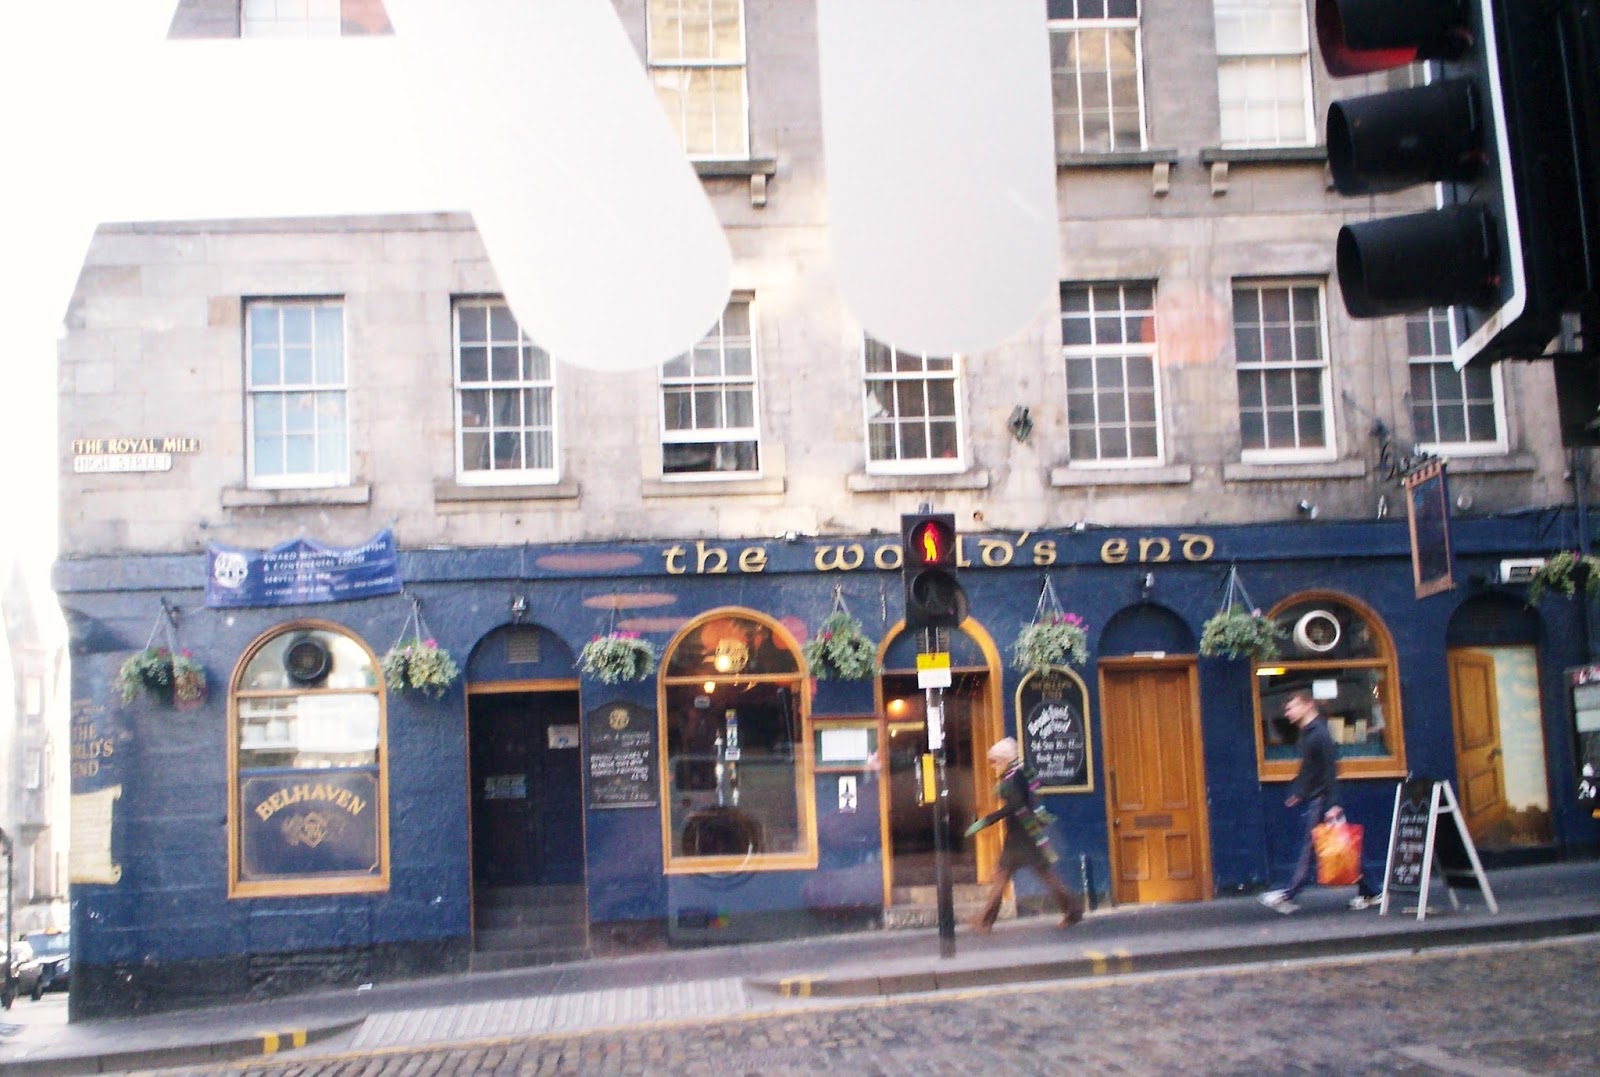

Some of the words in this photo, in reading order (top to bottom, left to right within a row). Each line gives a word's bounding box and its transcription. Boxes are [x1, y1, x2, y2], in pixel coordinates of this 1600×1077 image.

[76, 440, 103, 454] THE
[108, 438, 158, 454] ROYAL
[162, 437, 198, 453] MILE
[662, 540, 768, 575] the
[814, 531, 1058, 571] wold's
[1100, 533, 1215, 565] end
[255, 783, 367, 821] BELHAVEN
